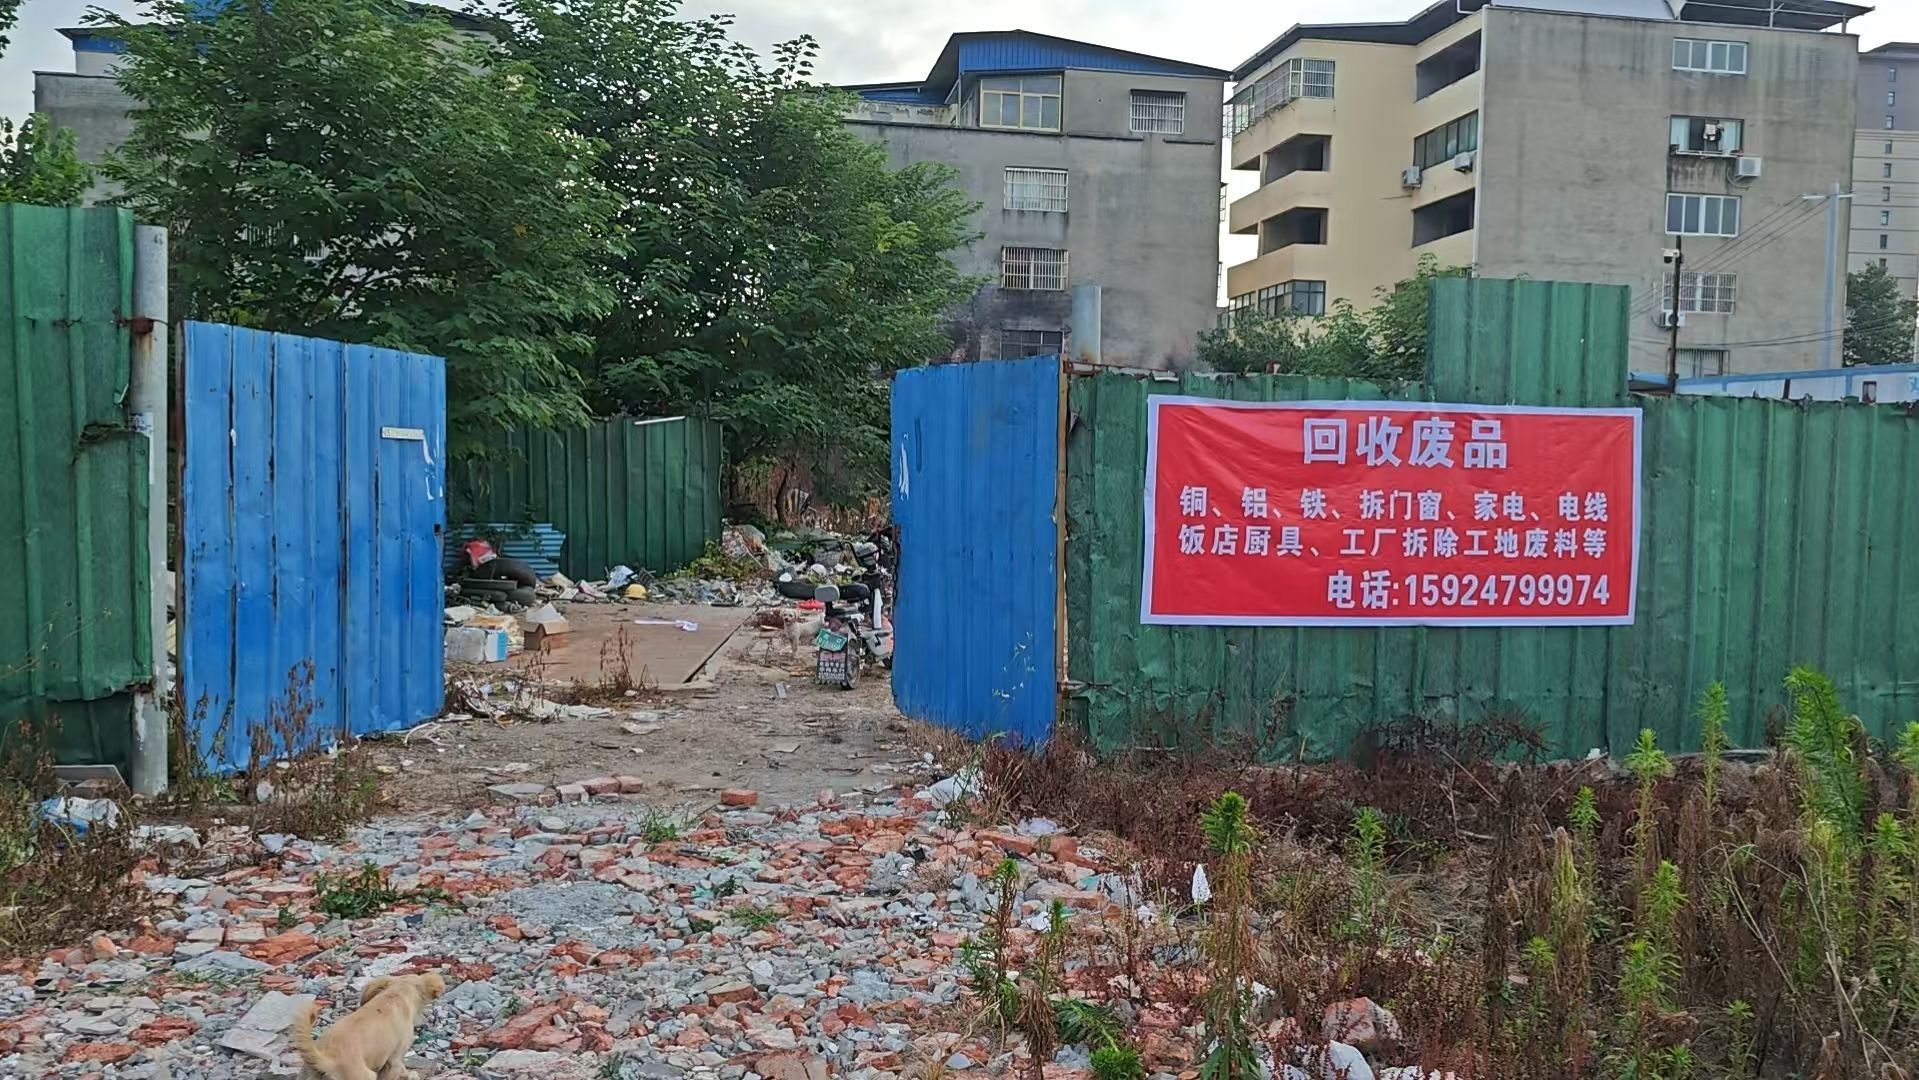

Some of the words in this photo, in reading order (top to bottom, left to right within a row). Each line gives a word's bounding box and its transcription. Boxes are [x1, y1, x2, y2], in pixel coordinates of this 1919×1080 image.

[1303, 416, 1508, 469] 回收废品
[1179, 485, 1608, 522] 铜、铝、铁、拆门窗、家电、电线
[1178, 524, 1607, 558] 饭店厨具、工厂拆除工地废料等
[1327, 569, 1610, 609] 电话:15924799974
